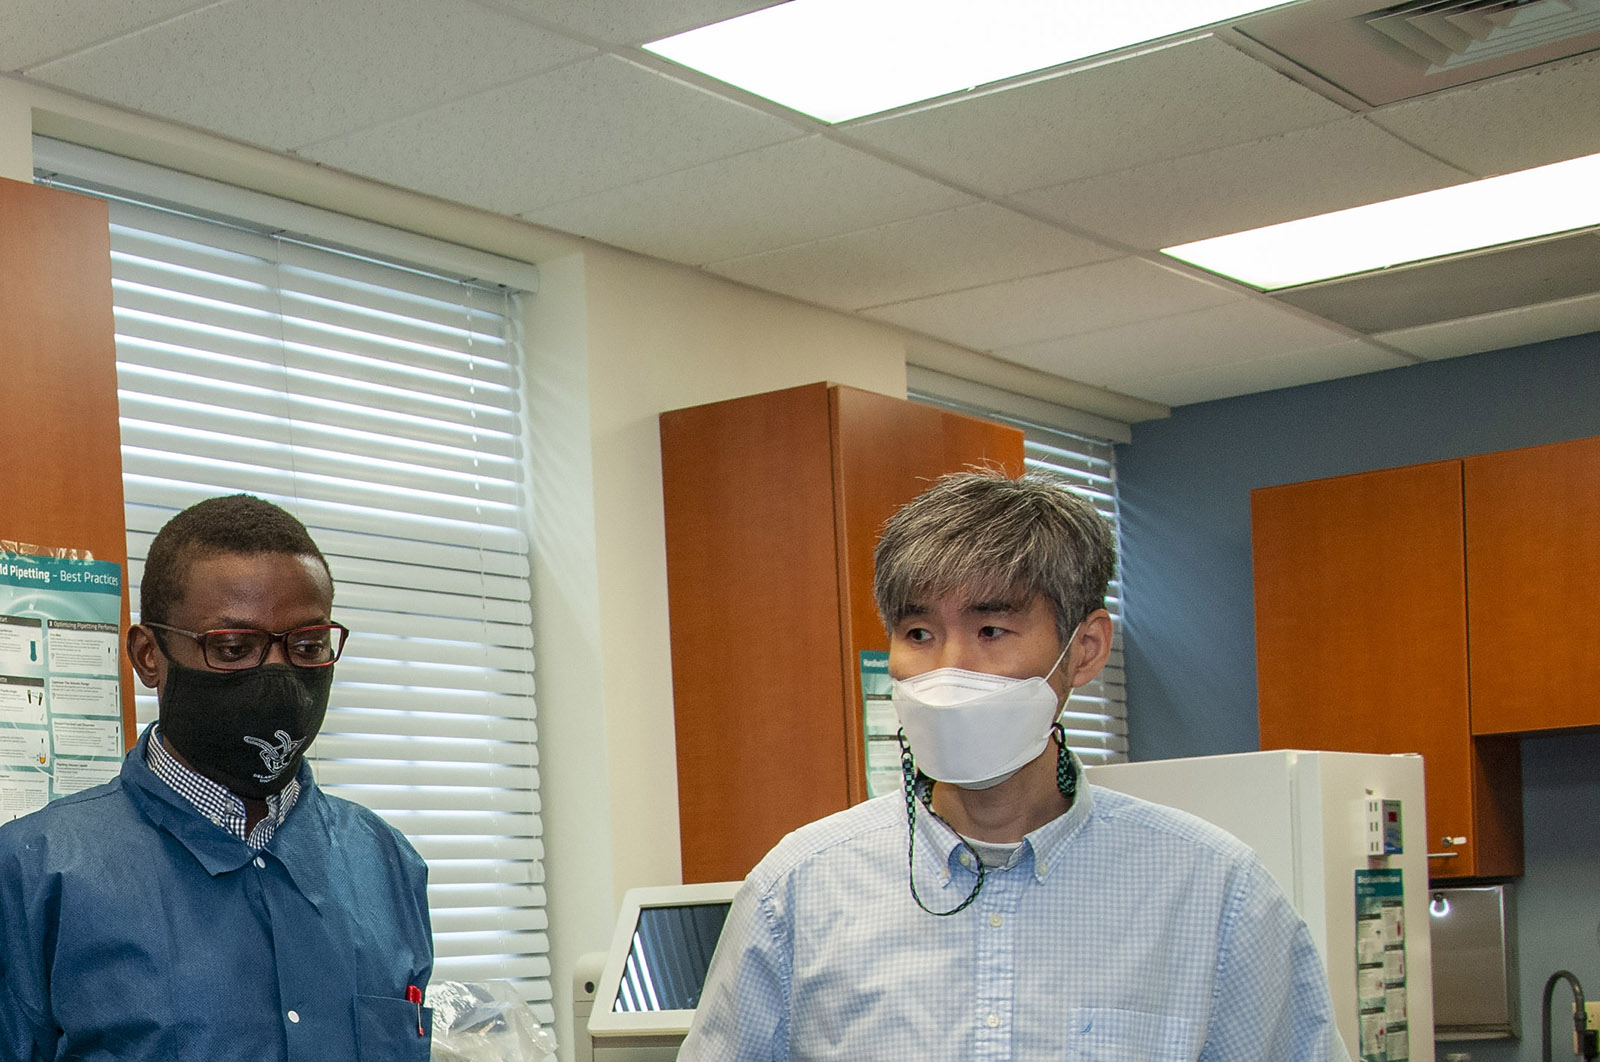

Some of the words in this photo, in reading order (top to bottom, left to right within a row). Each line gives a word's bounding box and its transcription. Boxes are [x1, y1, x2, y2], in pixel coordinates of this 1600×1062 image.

[10, 566, 50, 583] Pipetting
[60, 571, 82, 583] Best
[84, 573, 119, 587] Practices
